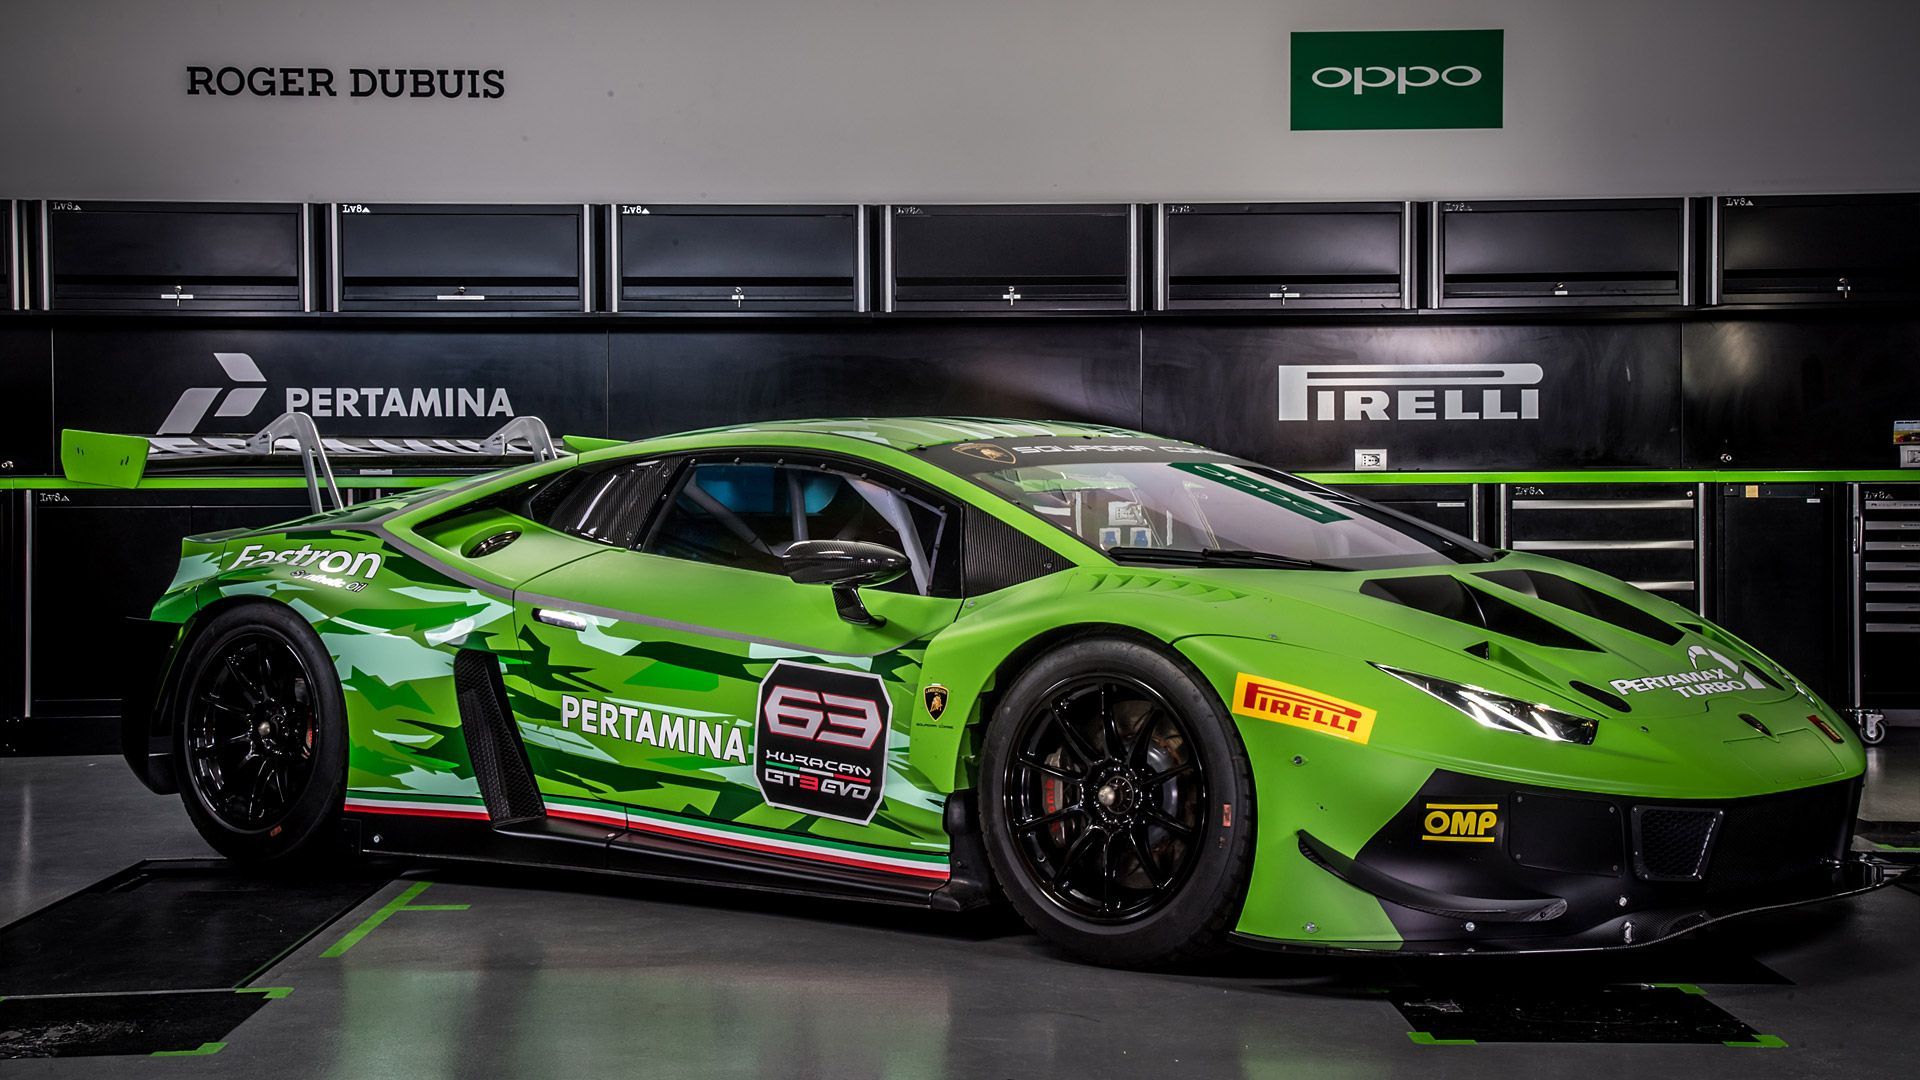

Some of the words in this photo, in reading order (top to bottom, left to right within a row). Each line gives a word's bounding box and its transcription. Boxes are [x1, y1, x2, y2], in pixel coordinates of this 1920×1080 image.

[186, 66, 337, 98] ROGER
[349, 68, 505, 100] DUBUIS
[1311, 65, 1482, 95] oppo
[286, 387, 515, 418] PERTAMINA
[1278, 362, 1544, 422] PIRELLI
[226, 543, 382, 580] Fastron
[1609, 668, 1731, 696] PERTAMAX
[1671, 680, 1747, 699] TURBO
[764, 685, 883, 751] 63
[1242, 681, 1362, 734] PIRELLI
[560, 693, 747, 765] PERTAMINA
[764, 768, 819, 791] GT3
[820, 778, 872, 801] EVO
[1423, 810, 1498, 838] OMP
